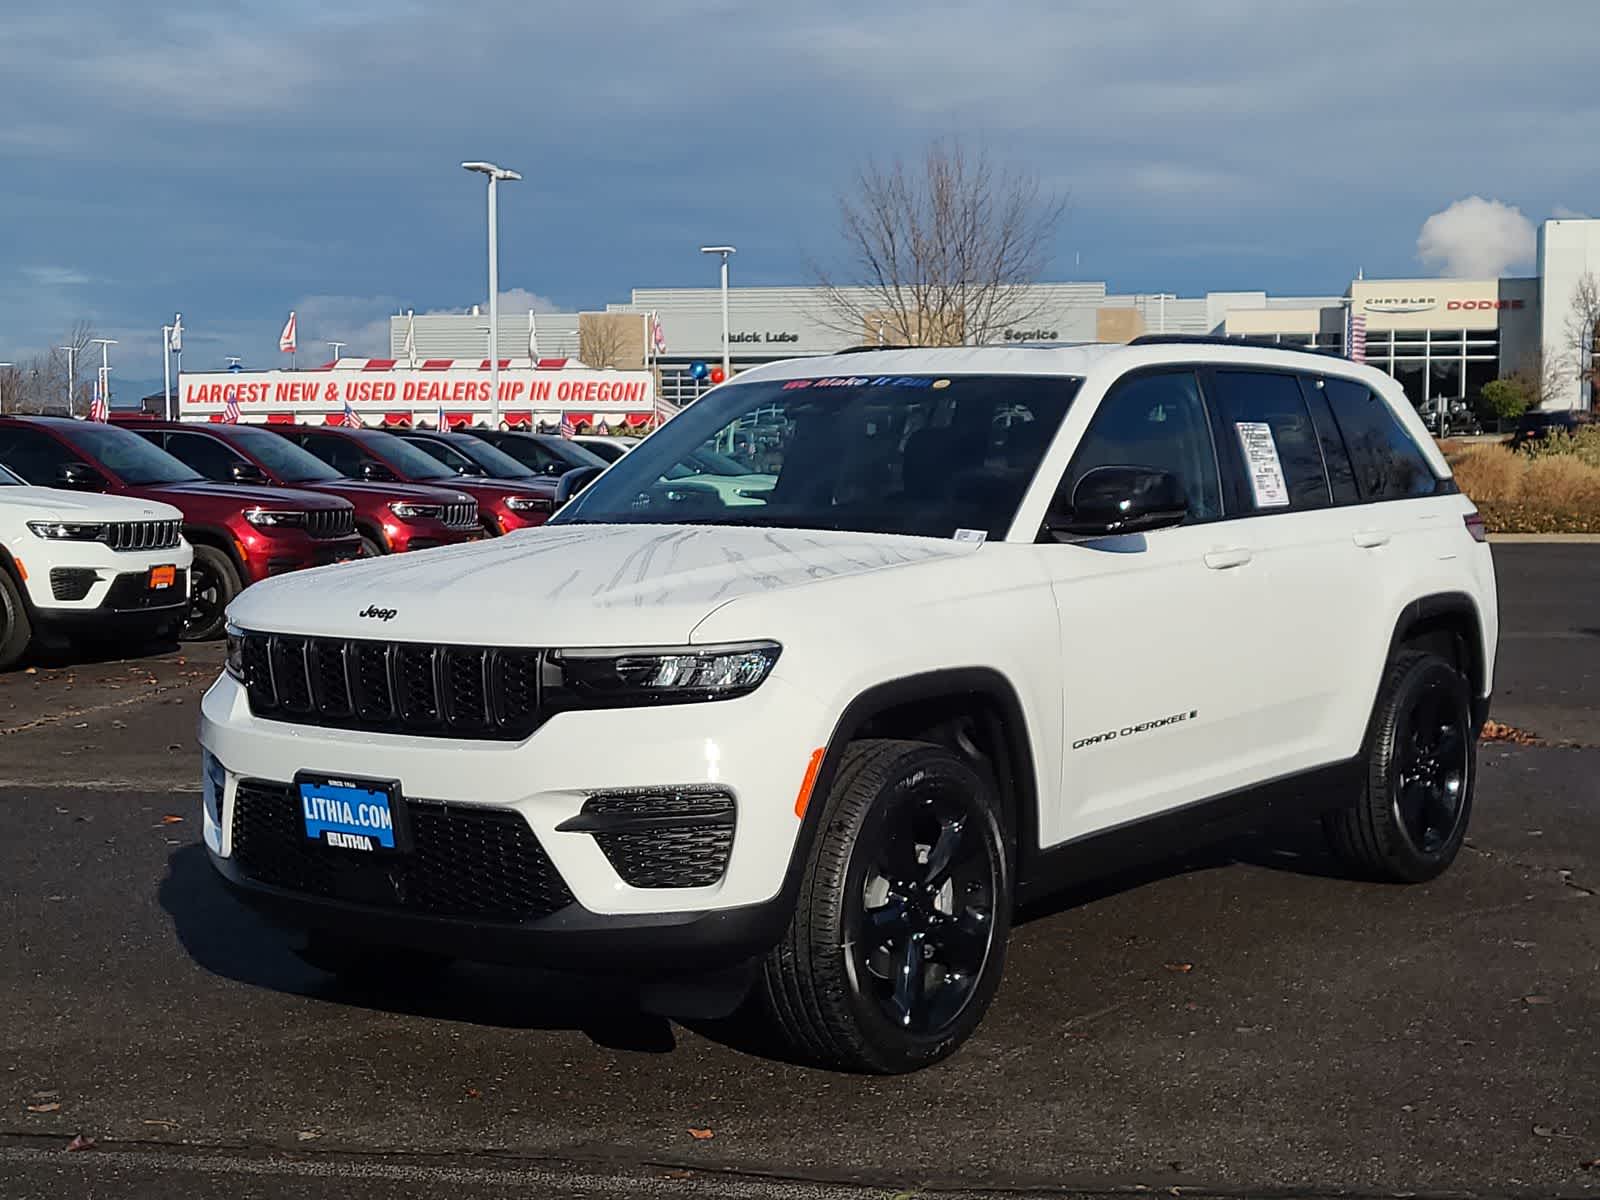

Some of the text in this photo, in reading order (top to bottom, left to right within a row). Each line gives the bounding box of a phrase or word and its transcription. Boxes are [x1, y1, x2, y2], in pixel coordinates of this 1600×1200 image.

[1365, 297, 1436, 305] CHRYSLER
[765, 331, 799, 343] Lube
[186, 381, 648, 404] LARGEST NEW & USED DEALERSHIP IN OREGON!
[359, 604, 398, 622] Jeep
[1072, 712, 1187, 750] GRAND CHEROKEE
[303, 796, 393, 830] LITHIA.COM
